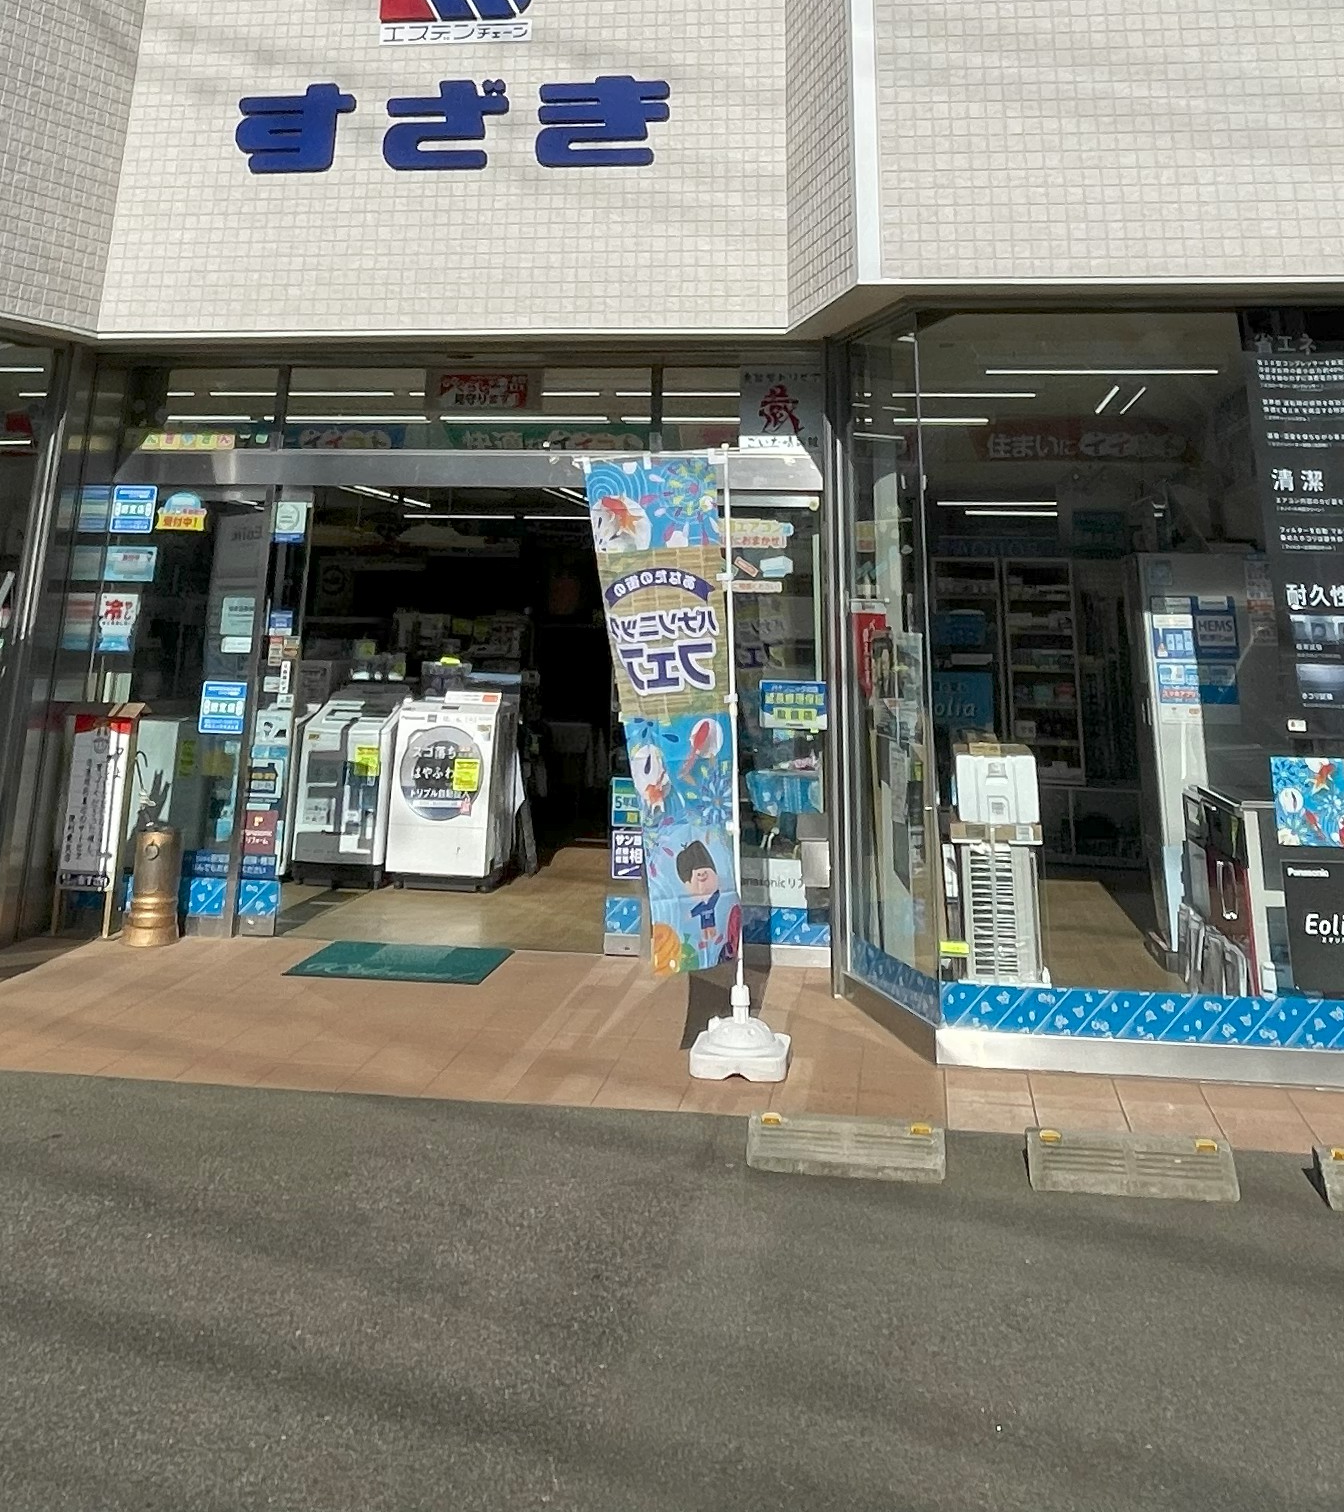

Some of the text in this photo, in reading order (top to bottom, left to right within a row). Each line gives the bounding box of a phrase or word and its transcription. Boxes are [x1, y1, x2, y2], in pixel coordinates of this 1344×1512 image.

[383, 22, 529, 42] エスデンチェーン
[235, 75, 671, 175] すざき
[1270, 468, 1324, 492] 清潔
[1198, 620, 1233, 632] HEMS
